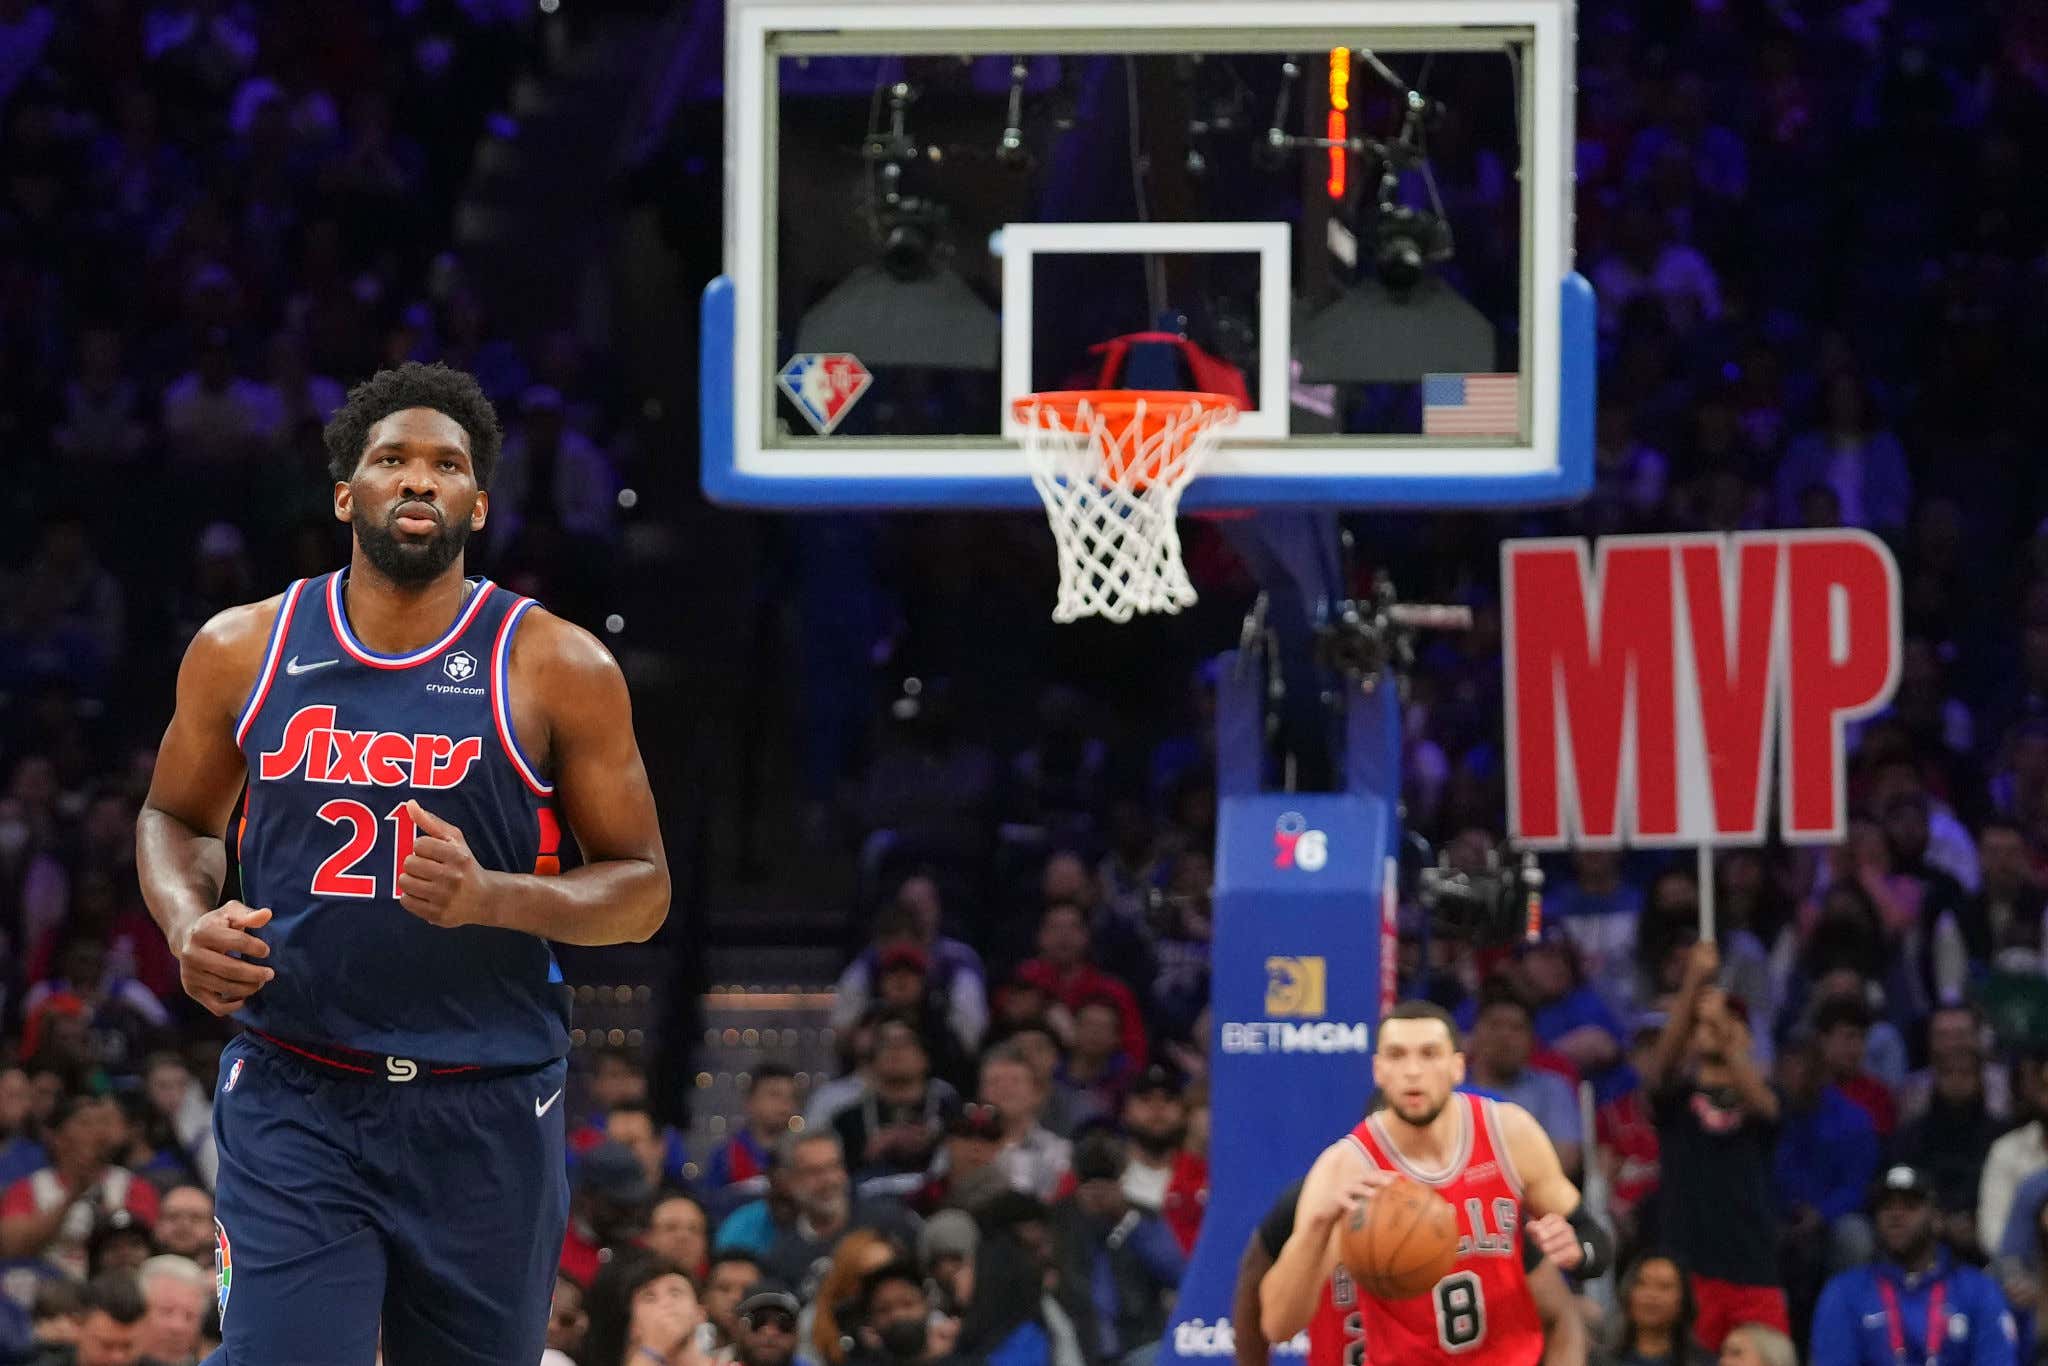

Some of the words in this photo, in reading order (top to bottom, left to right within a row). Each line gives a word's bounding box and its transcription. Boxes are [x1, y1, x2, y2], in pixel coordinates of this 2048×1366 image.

[425, 682, 485, 696] crypto.com
[1508, 537, 1892, 840] MVP
[260, 704, 482, 790] Sixers
[310, 798, 417, 900] 21
[1273, 829, 1328, 872] 76
[1221, 1022, 1369, 1054] BETMGM
[1432, 1269, 1487, 1354] 8
